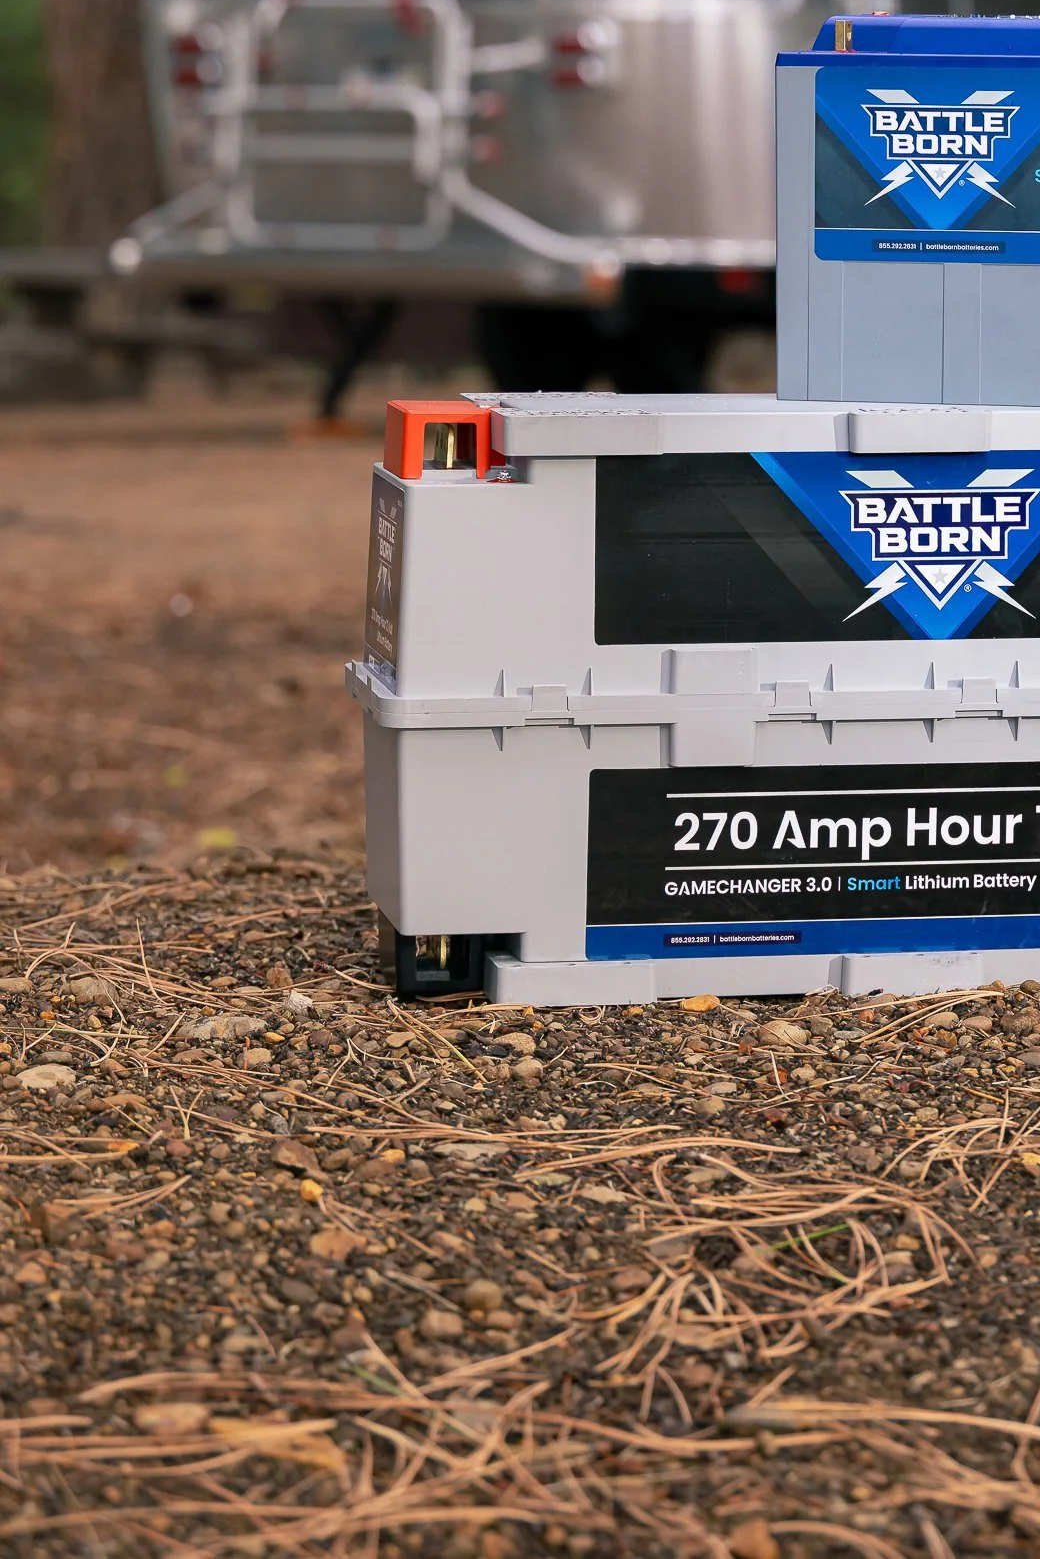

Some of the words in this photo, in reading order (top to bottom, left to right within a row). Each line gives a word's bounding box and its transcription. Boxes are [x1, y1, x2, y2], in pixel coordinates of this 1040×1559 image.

[874, 110, 1005, 132] BATTLE
[890, 133, 988, 155] BORN
[855, 496, 1022, 524] BATTLE
[378, 515, 395, 544] BATTLE
[877, 526, 1001, 553] BORN
[673, 811, 758, 851] 270
[772, 810, 892, 860] Amp
[906, 807, 1023, 847] Hour
[664, 878, 802, 896] GAMECHANGER
[806, 876, 832, 892] 3.0
[847, 875, 901, 891] Smart
[905, 874, 970, 890] Lithium
[973, 873, 1038, 891] Battery
